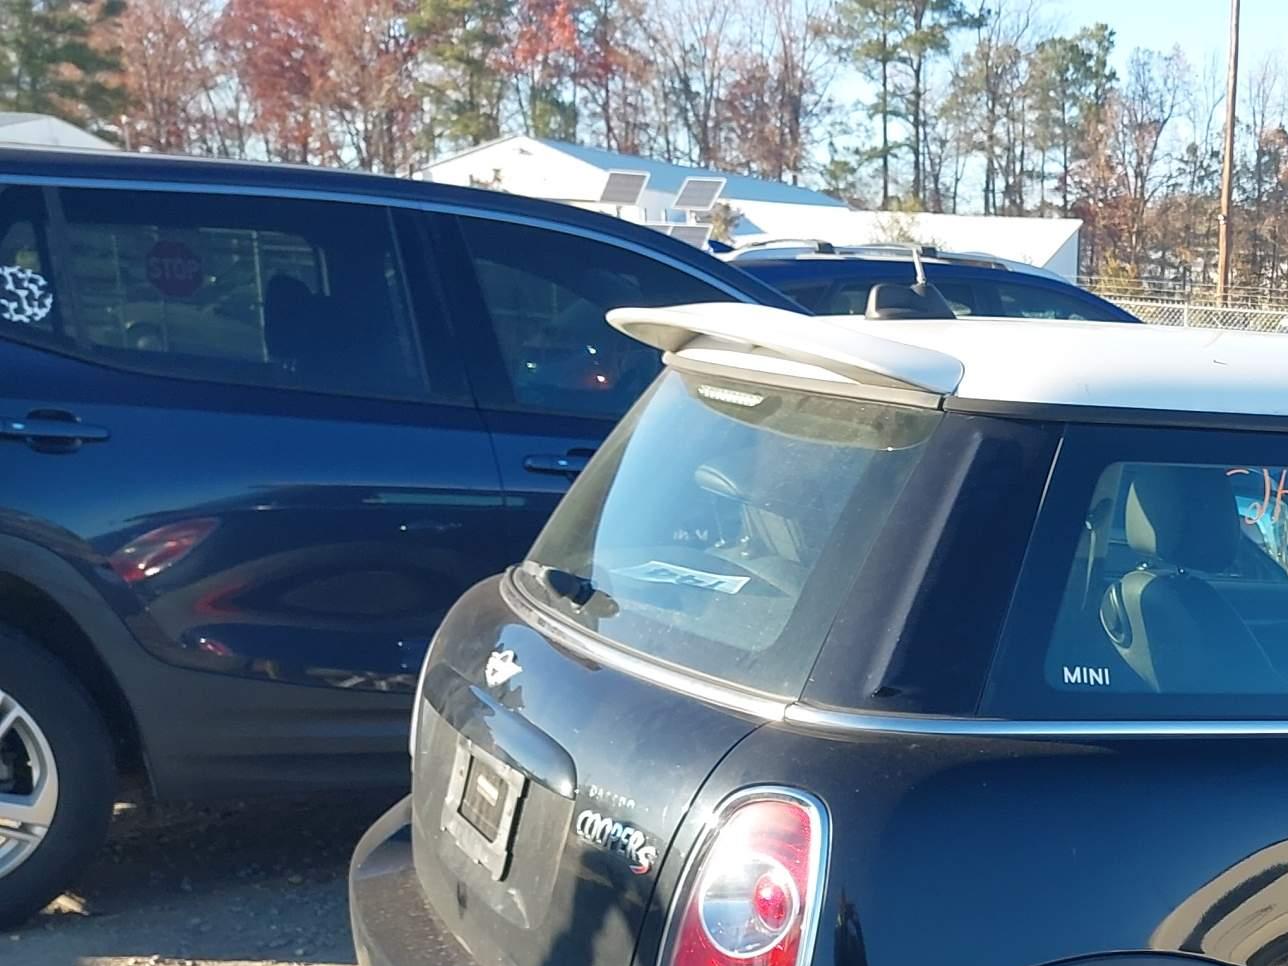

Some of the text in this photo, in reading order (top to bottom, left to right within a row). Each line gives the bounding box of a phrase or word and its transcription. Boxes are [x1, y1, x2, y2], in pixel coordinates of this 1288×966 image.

[148, 256, 200, 280] STOP
[1063, 666, 1110, 686] MINI
[576, 809, 660, 876] COOPER S
